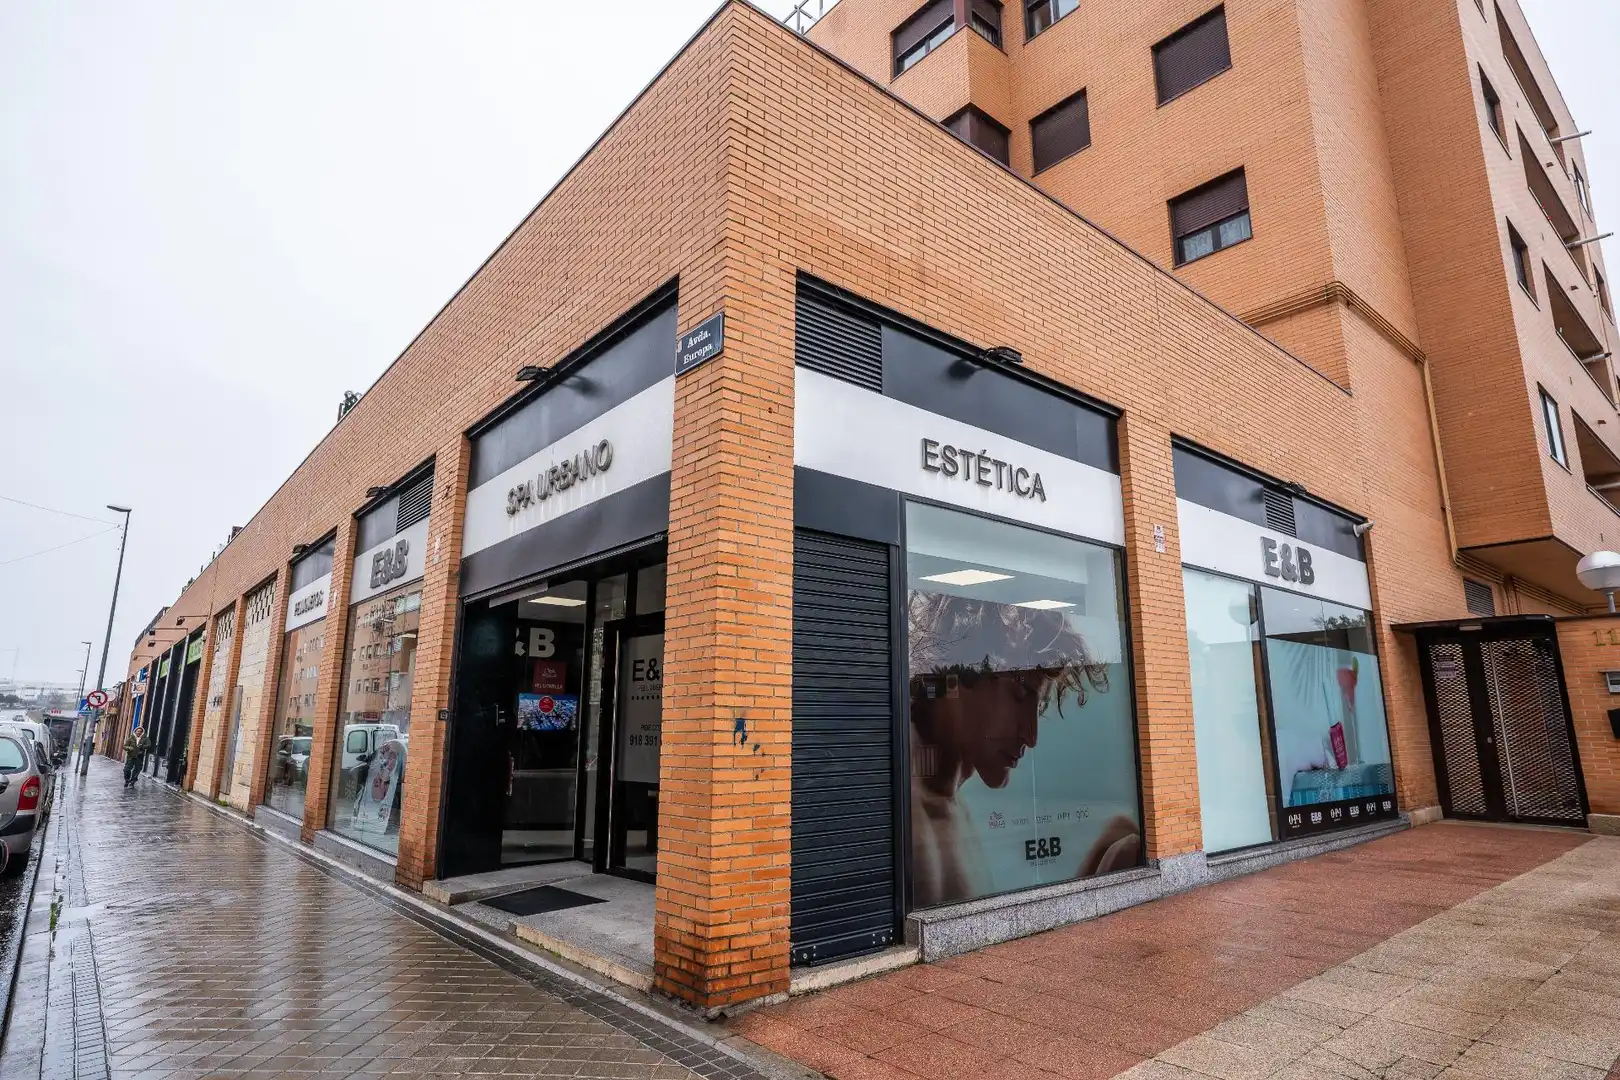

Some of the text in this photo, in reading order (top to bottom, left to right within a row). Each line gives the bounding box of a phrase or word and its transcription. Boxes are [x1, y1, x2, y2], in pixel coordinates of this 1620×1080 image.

[683, 343, 712, 365] Europa
[687, 330, 711, 349] Avda.
[506, 438, 614, 516] SPA URBANO
[921, 437, 1047, 502] ESTÉTICA
[370, 538, 409, 589] E&B
[1260, 535, 1316, 586] E&B
[632, 657, 661, 683] E&
[1025, 836, 1061, 860] E&B
